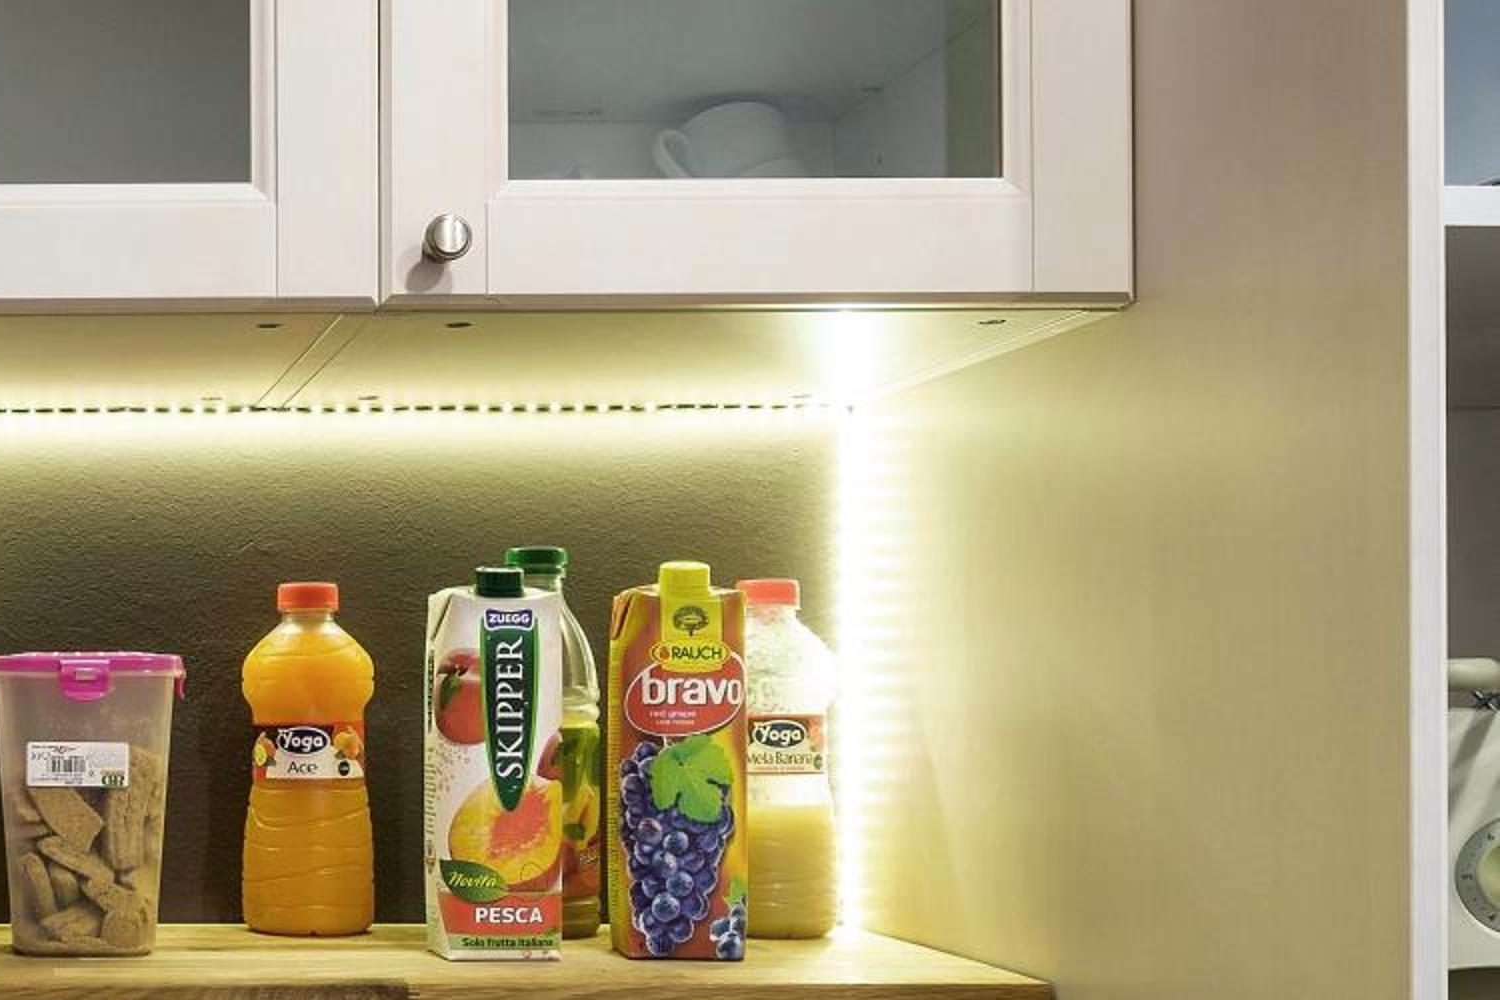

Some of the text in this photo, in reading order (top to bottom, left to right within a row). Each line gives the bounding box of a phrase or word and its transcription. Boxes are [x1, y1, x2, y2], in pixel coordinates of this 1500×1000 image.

[488, 613, 530, 623] ZUEGG
[671, 645, 722, 660] RAUCH
[640, 670, 743, 705] bravo
[495, 635, 524, 779] SKIPPER
[278, 729, 324, 751] Yoga
[754, 722, 802, 746] Yoga
[287, 761, 318, 774] Ace
[475, 907, 543, 923] PESCA
